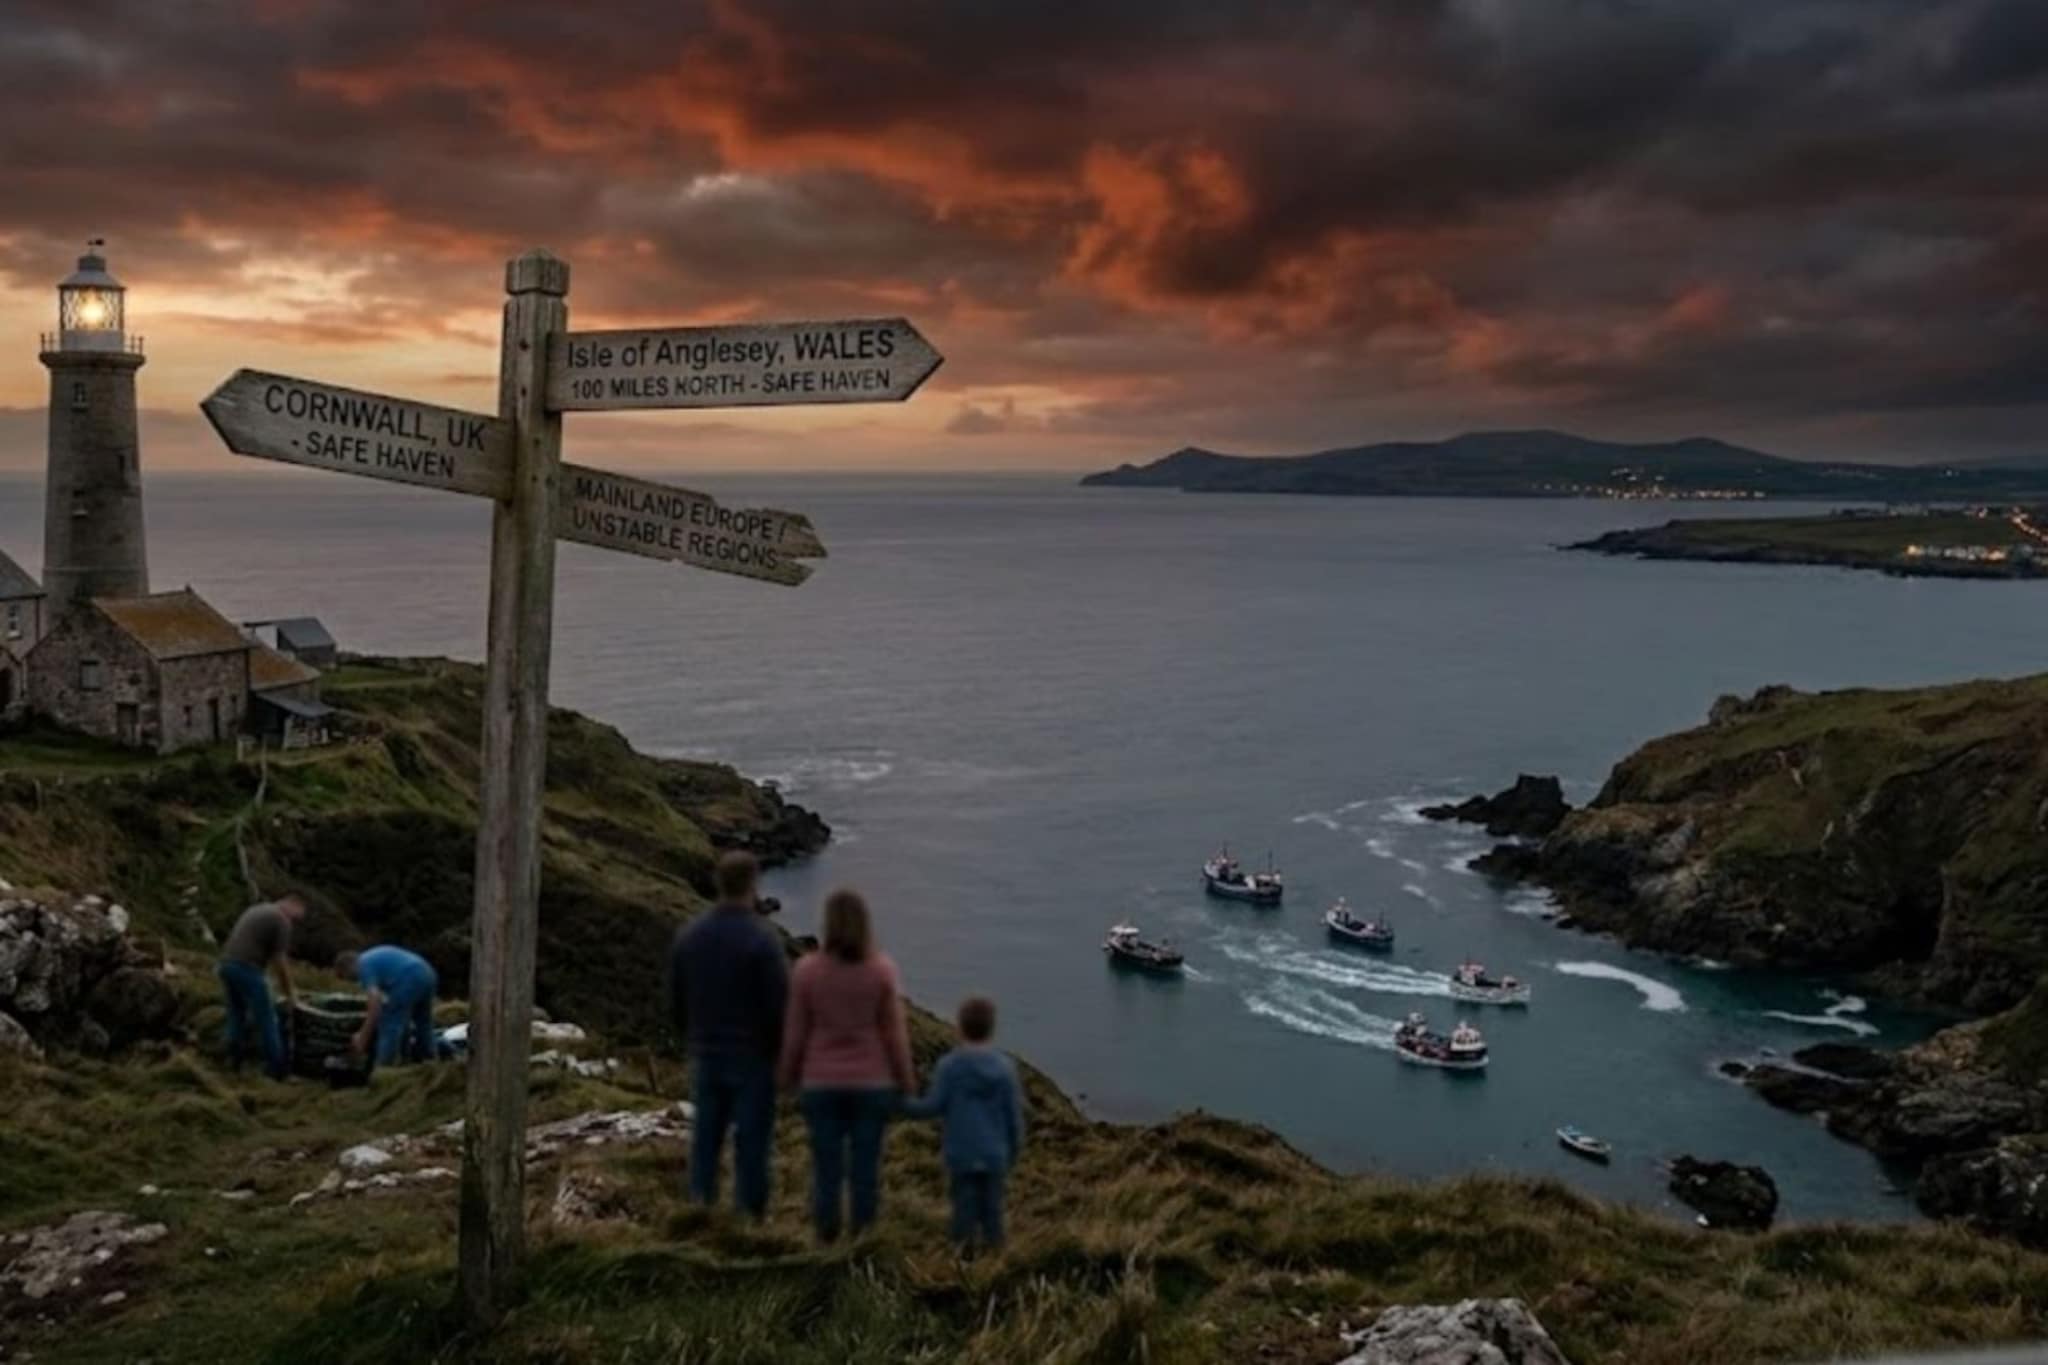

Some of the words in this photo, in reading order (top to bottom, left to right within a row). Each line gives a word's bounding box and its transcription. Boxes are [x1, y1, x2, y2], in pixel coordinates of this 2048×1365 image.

[567, 341, 613, 368] Isle
[621, 337, 650, 366] of
[655, 335, 785, 370] Anglesey,
[793, 329, 895, 361] WALES
[572, 378, 604, 399] 100
[610, 376, 668, 397] MILES
[762, 371, 815, 393] SAFE
[821, 369, 890, 391] HAVEN
[264, 384, 438, 447] CORNWALL,
[447, 417, 486, 450] UK
[306, 431, 369, 463] SAFE
[376, 442, 455, 478] HAVEN
[575, 477, 685, 520] MAINLAND
[690, 502, 773, 540] EUROPE
[572, 507, 683, 549] UNSTABLE
[688, 531, 779, 568] REGIONS
